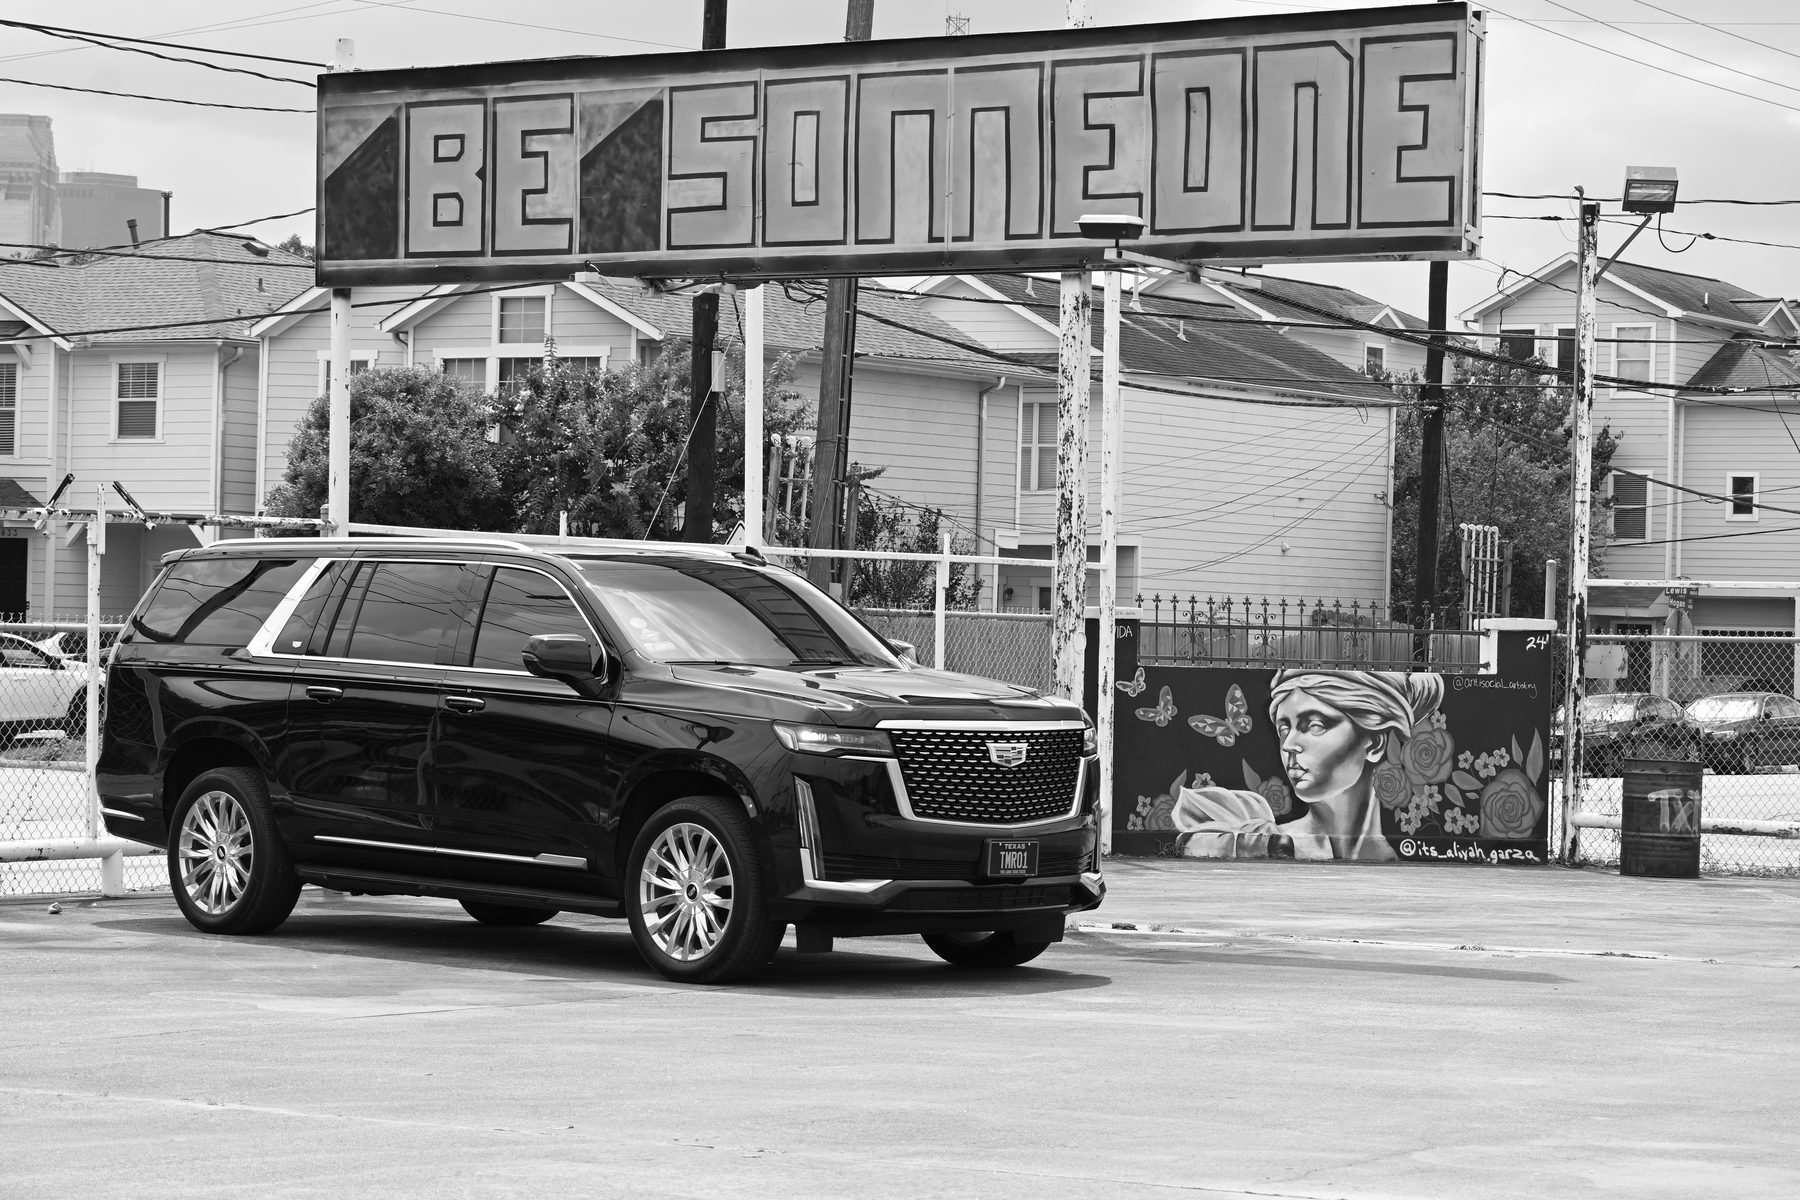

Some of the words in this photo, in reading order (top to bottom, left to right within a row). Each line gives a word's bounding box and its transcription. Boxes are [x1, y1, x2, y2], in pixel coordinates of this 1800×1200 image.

[404, 93, 574, 257] BE
[666, 32, 1457, 249] SOMEONE
[1665, 587, 1688, 595] Lewis
[1669, 598, 1686, 609] Hogan
[1115, 626, 1133, 639] IDA
